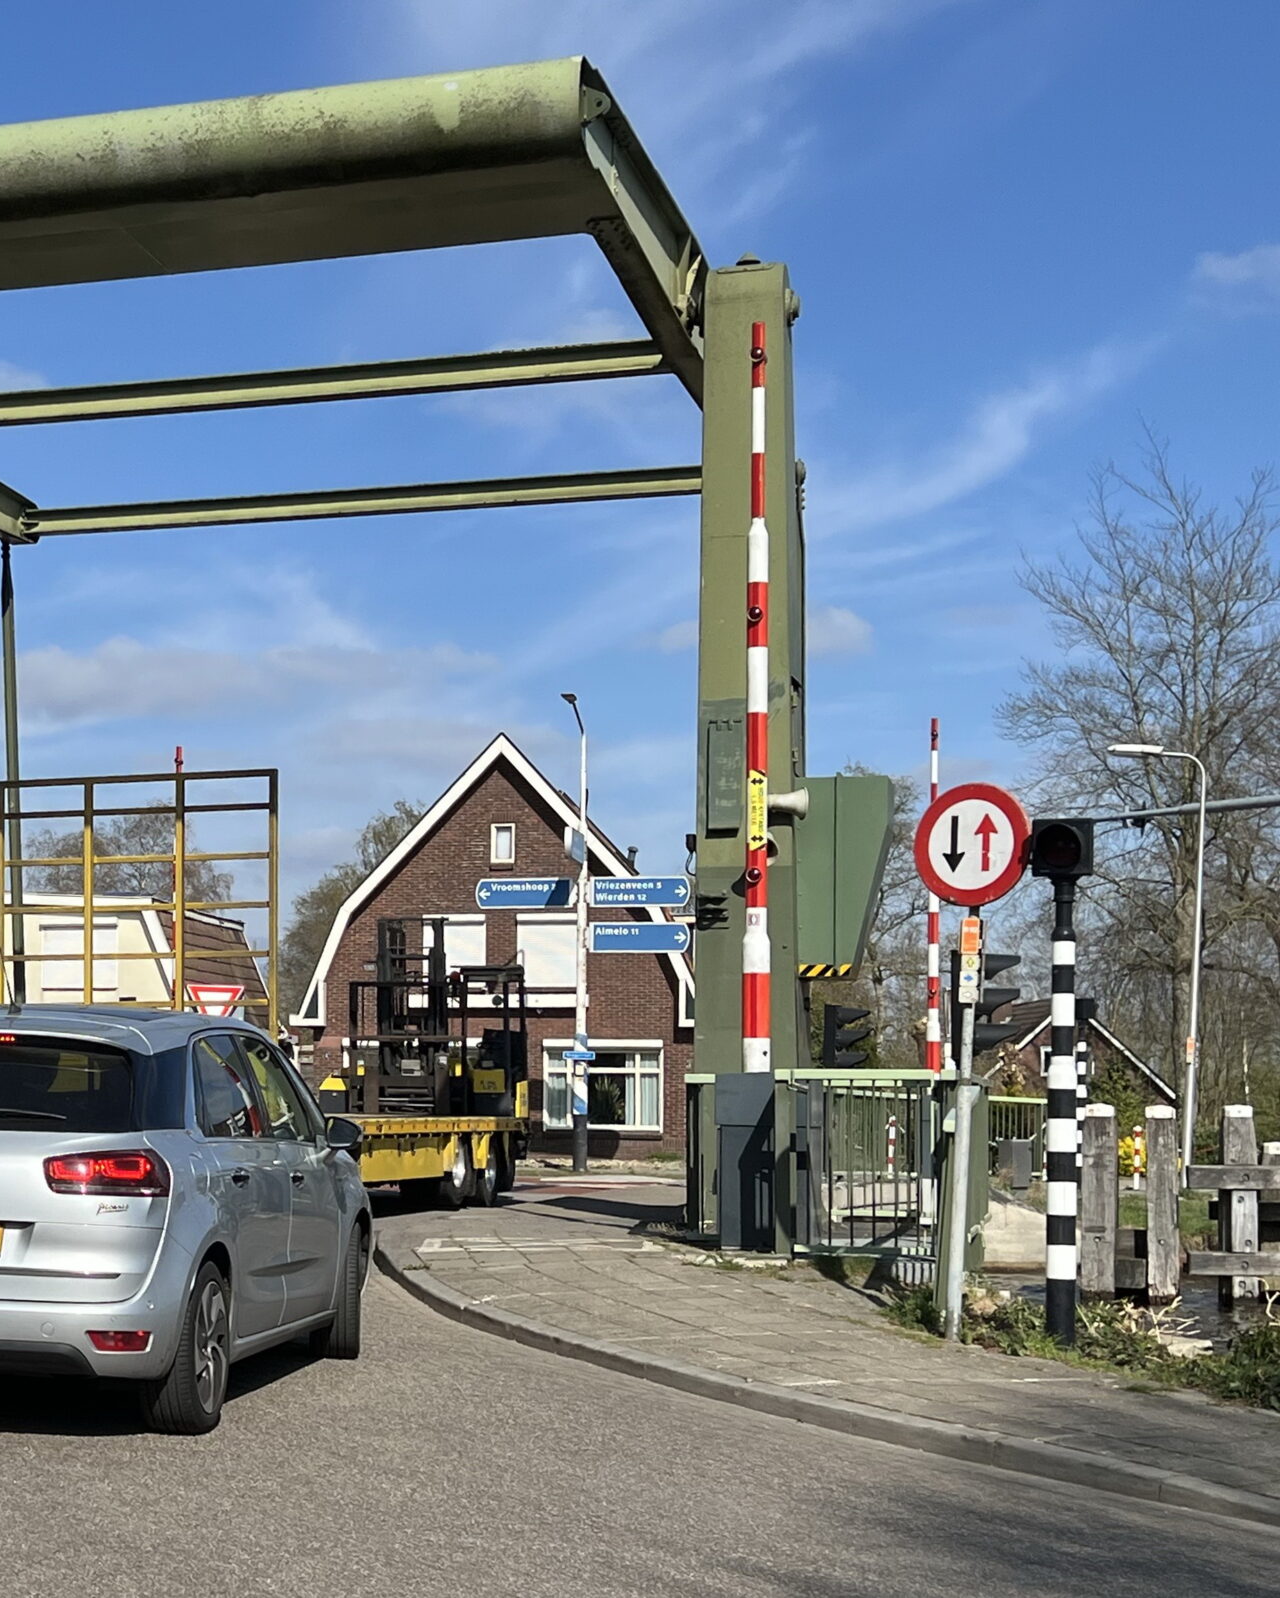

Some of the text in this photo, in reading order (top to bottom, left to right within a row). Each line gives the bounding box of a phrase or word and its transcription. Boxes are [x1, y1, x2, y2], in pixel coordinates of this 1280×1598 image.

[491, 882, 549, 892] Vroomshoop
[595, 881, 653, 890] Vriezenveen
[595, 893, 635, 901] Wierden
[595, 927, 629, 935] Almelo
